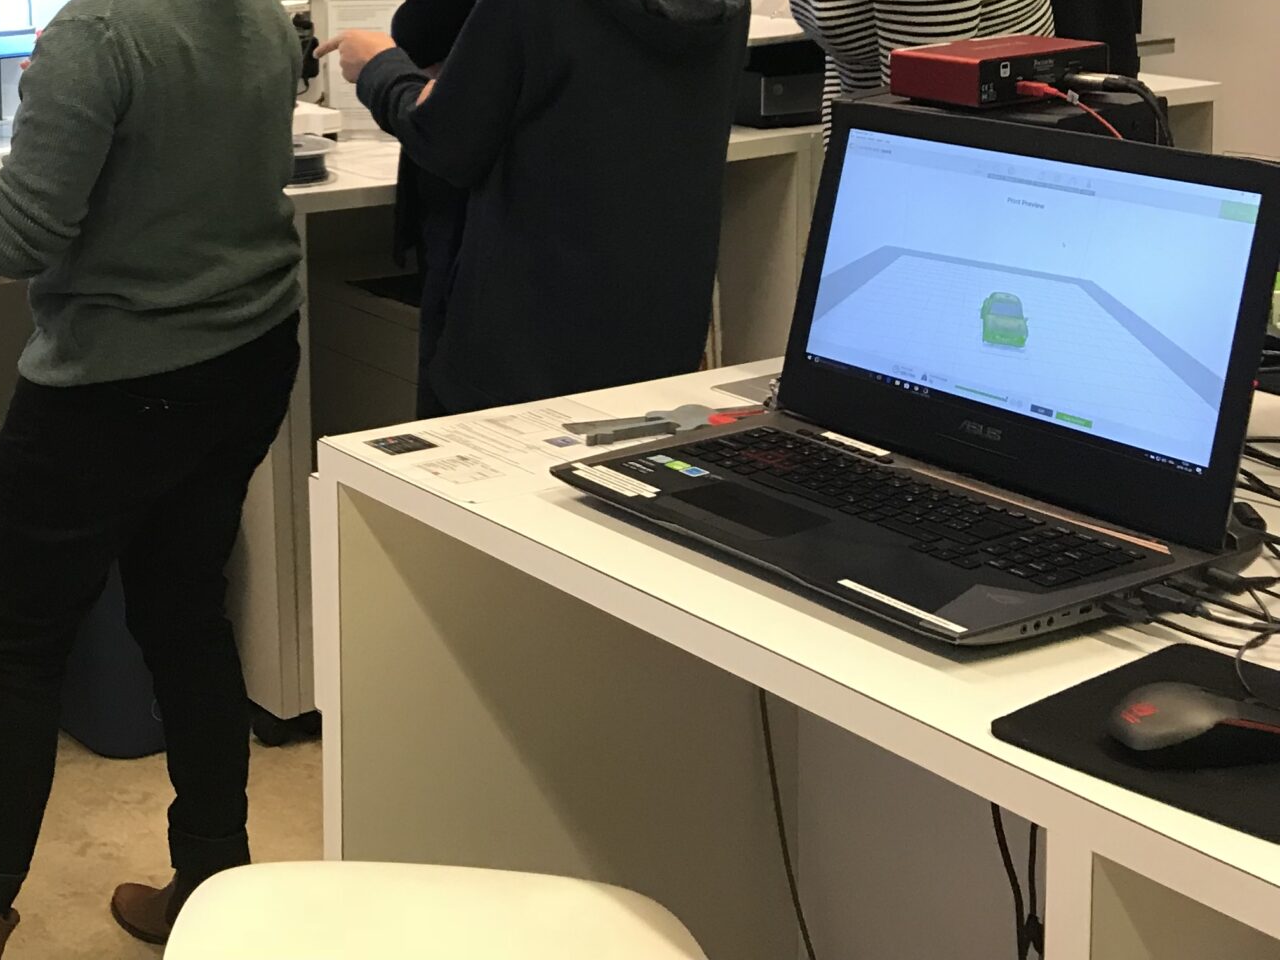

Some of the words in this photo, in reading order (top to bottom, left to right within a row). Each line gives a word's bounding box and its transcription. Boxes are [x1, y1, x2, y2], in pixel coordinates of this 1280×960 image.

[1007, 196, 1021, 206] Print
[1022, 198, 1045, 210] Preview
[957, 419, 1002, 441] ASUS
